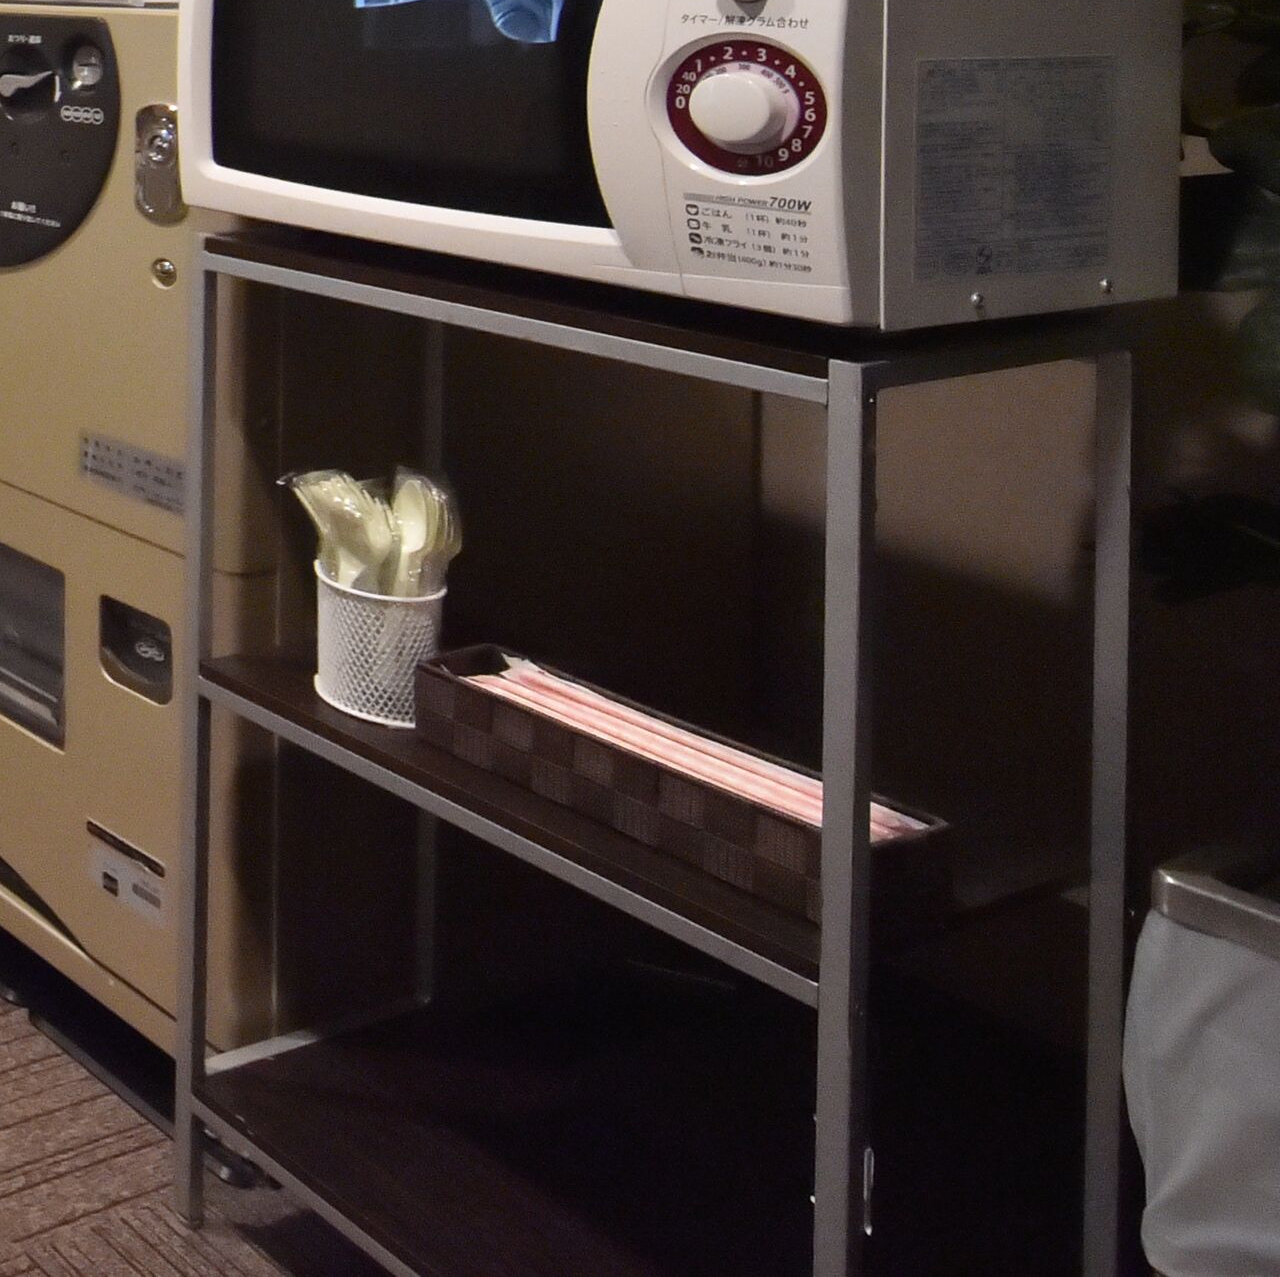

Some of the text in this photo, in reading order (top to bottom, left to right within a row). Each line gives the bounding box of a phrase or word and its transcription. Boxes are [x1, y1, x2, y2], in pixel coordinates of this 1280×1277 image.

[722, 46, 734, 61] 2
[756, 48, 767, 62] 3
[695, 59, 703, 73] 1
[785, 64, 797, 79] 4
[682, 71, 697, 83] 40
[676, 83, 691, 95] 20
[675, 96, 686, 109] 0
[805, 91, 815, 106] 5
[805, 108, 816, 122] 6
[802, 125, 813, 139] 7
[791, 138, 802, 153] 8
[756, 154, 774, 168] 10
[778, 148, 789, 162] 9
[769, 196, 812, 211] 700W
[702, 207, 733, 220] ごはん
